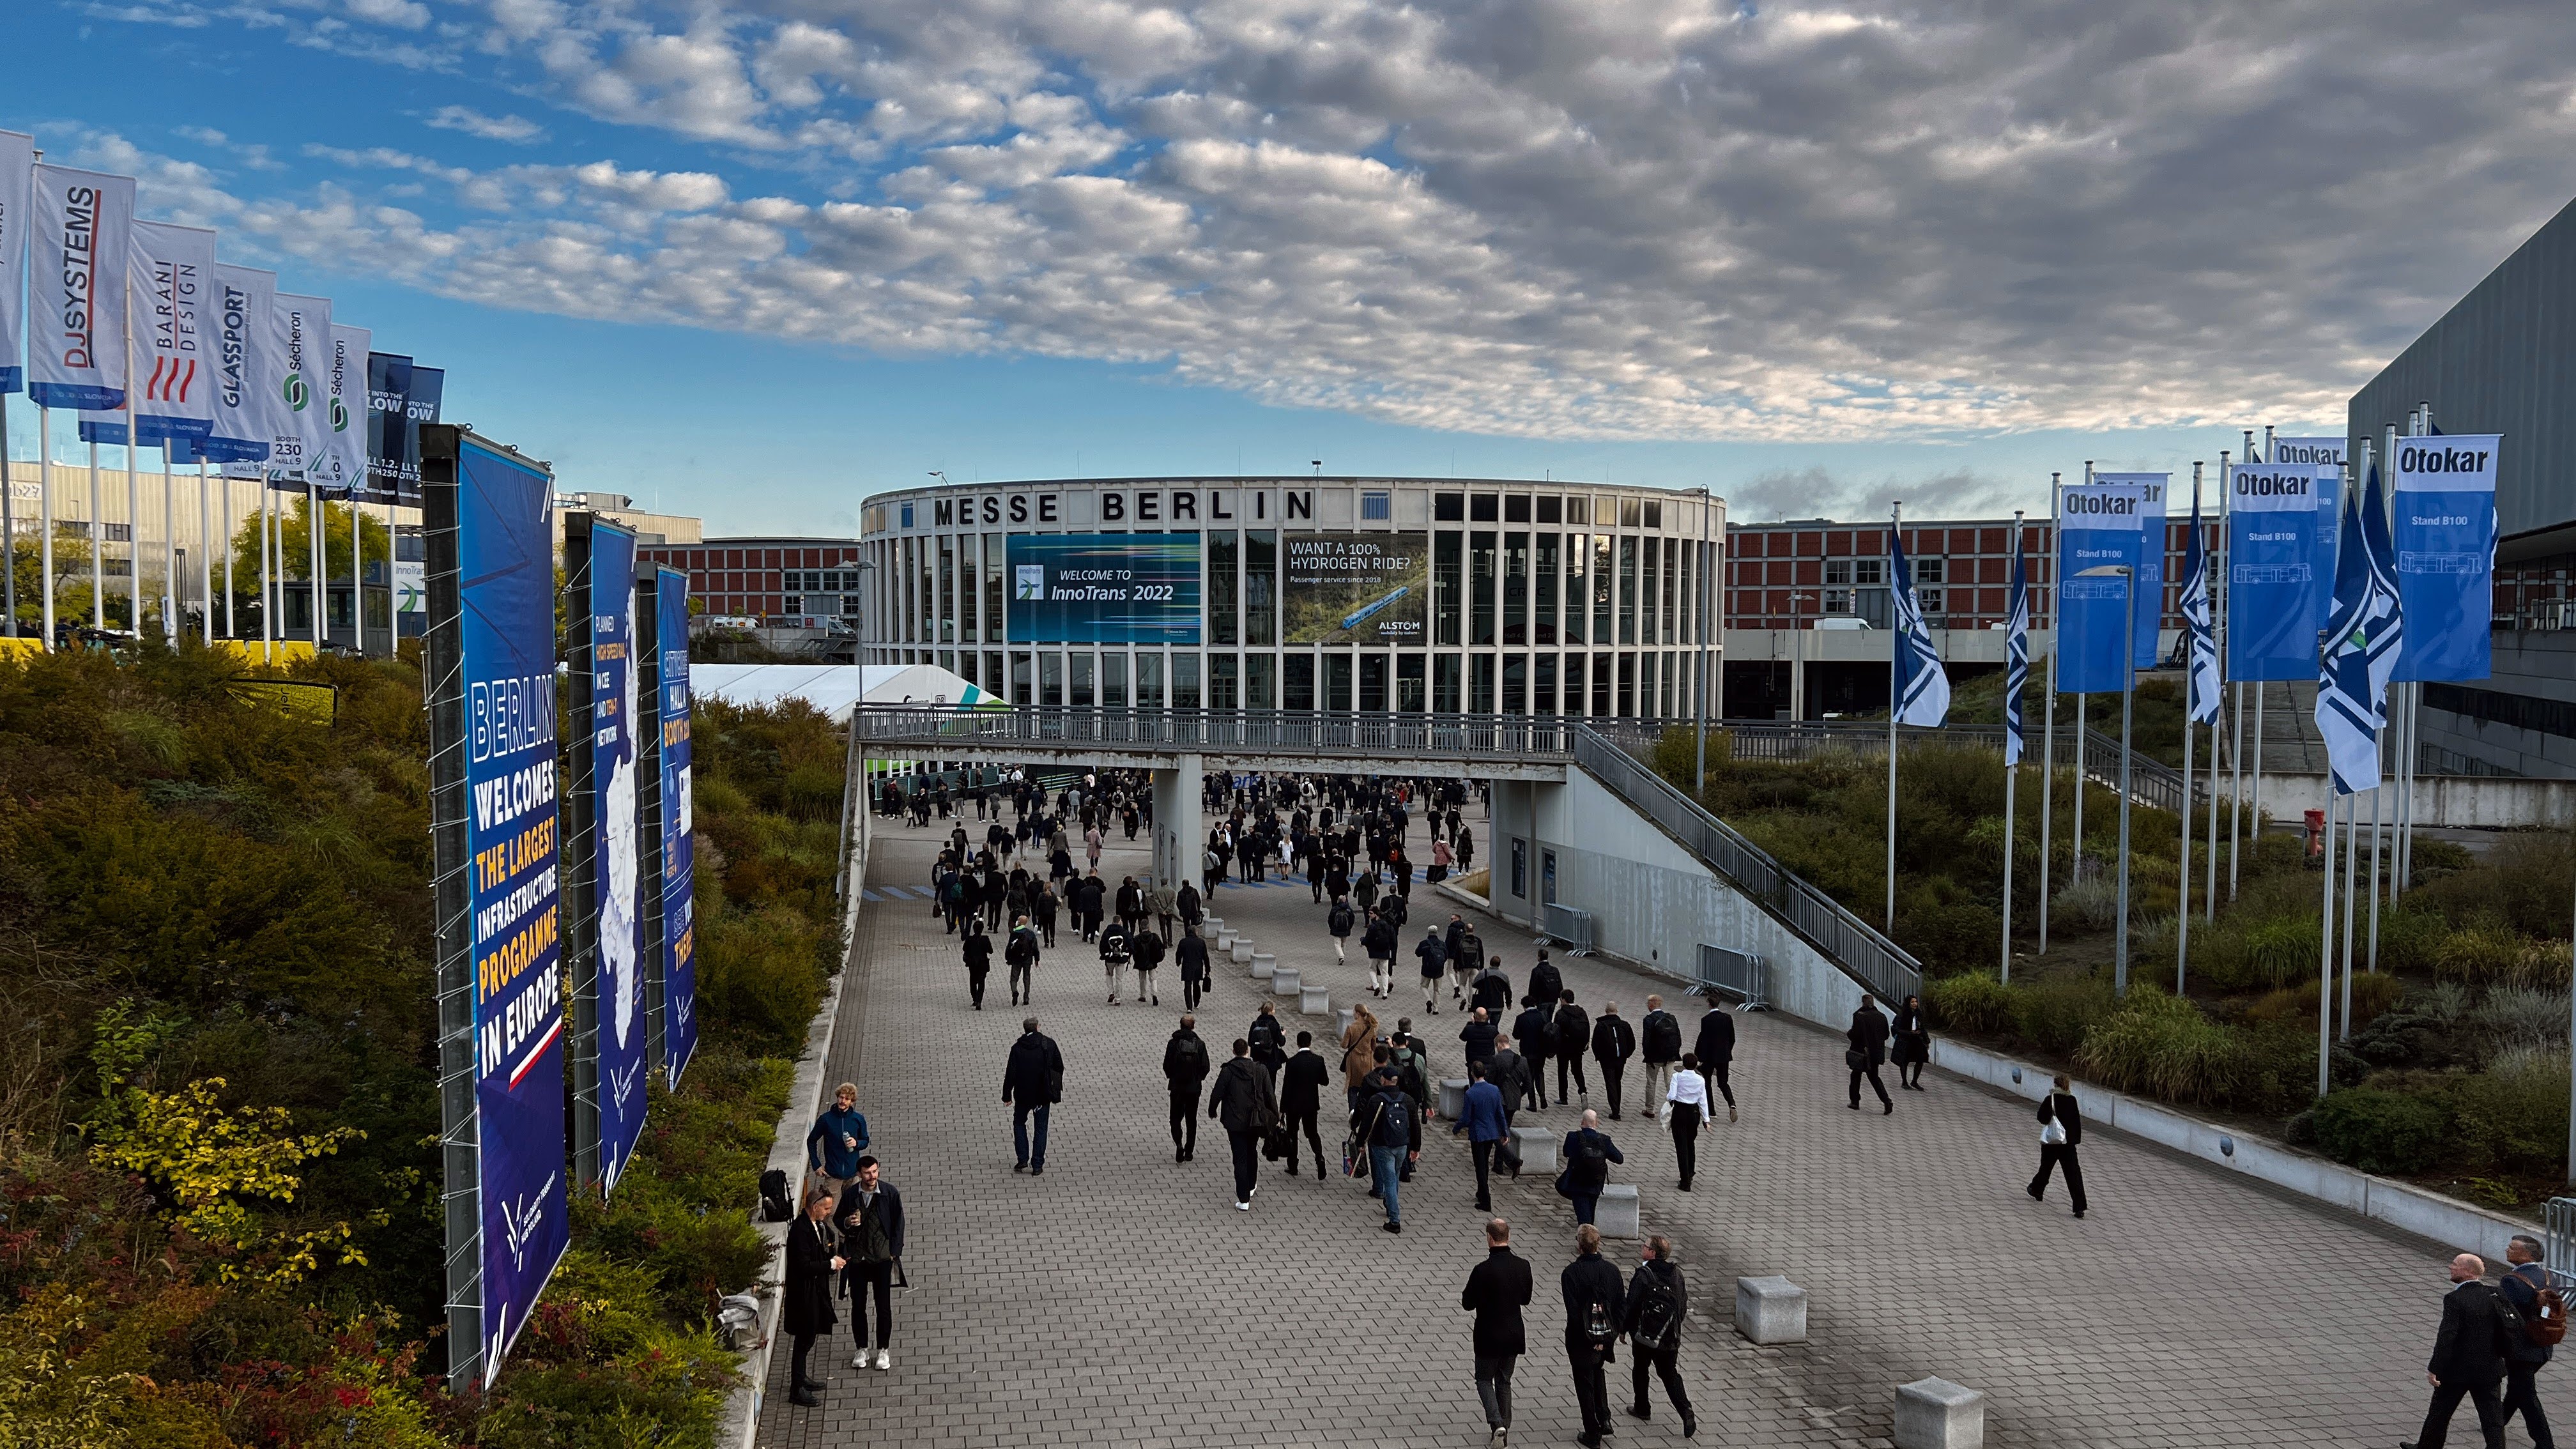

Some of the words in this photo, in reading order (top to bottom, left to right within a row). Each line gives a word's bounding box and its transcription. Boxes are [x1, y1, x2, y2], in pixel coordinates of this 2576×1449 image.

[155, 261, 173, 349] BARANI
[180, 264, 196, 351] DESIGN
[222, 286, 243, 408] GLASSPORT
[289, 310, 301, 371] Sécheron
[332, 340, 345, 396] Sécheron
[368, 396, 402, 413] LOW
[407, 407, 434, 420] OW
[275, 443, 302, 456] 230
[2280, 445, 2340, 465] Otokar
[2400, 447, 2489, 473] Otokar
[381, 459, 398, 468] 1.2.
[382, 468, 397, 478] 250
[2236, 472, 2310, 496] Otokar
[935, 494, 1057, 526] MESSE
[1103, 491, 1311, 520] BERLIN
[2066, 493, 2137, 516] Otokar
[2412, 516, 2438, 526] Stand
[2441, 516, 2468, 526] B100
[2248, 532, 2273, 541] Stand
[2274, 533, 2296, 541] B100
[1290, 542, 1333, 555] WANT
[1336, 542, 1345, 555] A
[1349, 543, 1381, 555] 100%
[2076, 549, 2100, 559] Stand
[2101, 549, 2122, 558] B100
[1291, 557, 1367, 570] HYDROGEN
[1373, 557, 1410, 570] RIDE?
[1060, 570, 1114, 581] WELCOME
[1116, 570, 1131, 580] TO
[1051, 585, 1127, 601] InnoTrans
[1133, 585, 1174, 601] 2022
[595, 615, 614, 632] PLANNED
[1379, 621, 1420, 631] ALSTOM
[1222, 656, 1254, 664] FRACE
[597, 673, 601, 690] IN
[670, 684, 683, 711] HALL
[471, 673, 553, 763] BERLIN
[597, 701, 606, 719] AND
[597, 724, 617, 747] NETWORK
[664, 718, 684, 748] BOOTH
[474, 758, 555, 832] WELCOMES
[477, 843, 505, 893] THE
[509, 816, 555, 877] LARGEST
[478, 863, 556, 944] INFRASTRUCTURE
[674, 905, 685, 939] SEE
[479, 903, 557, 1006] PROGRAMME
[481, 1015, 502, 1080] IN
[506, 959, 558, 1055] EUROPE
